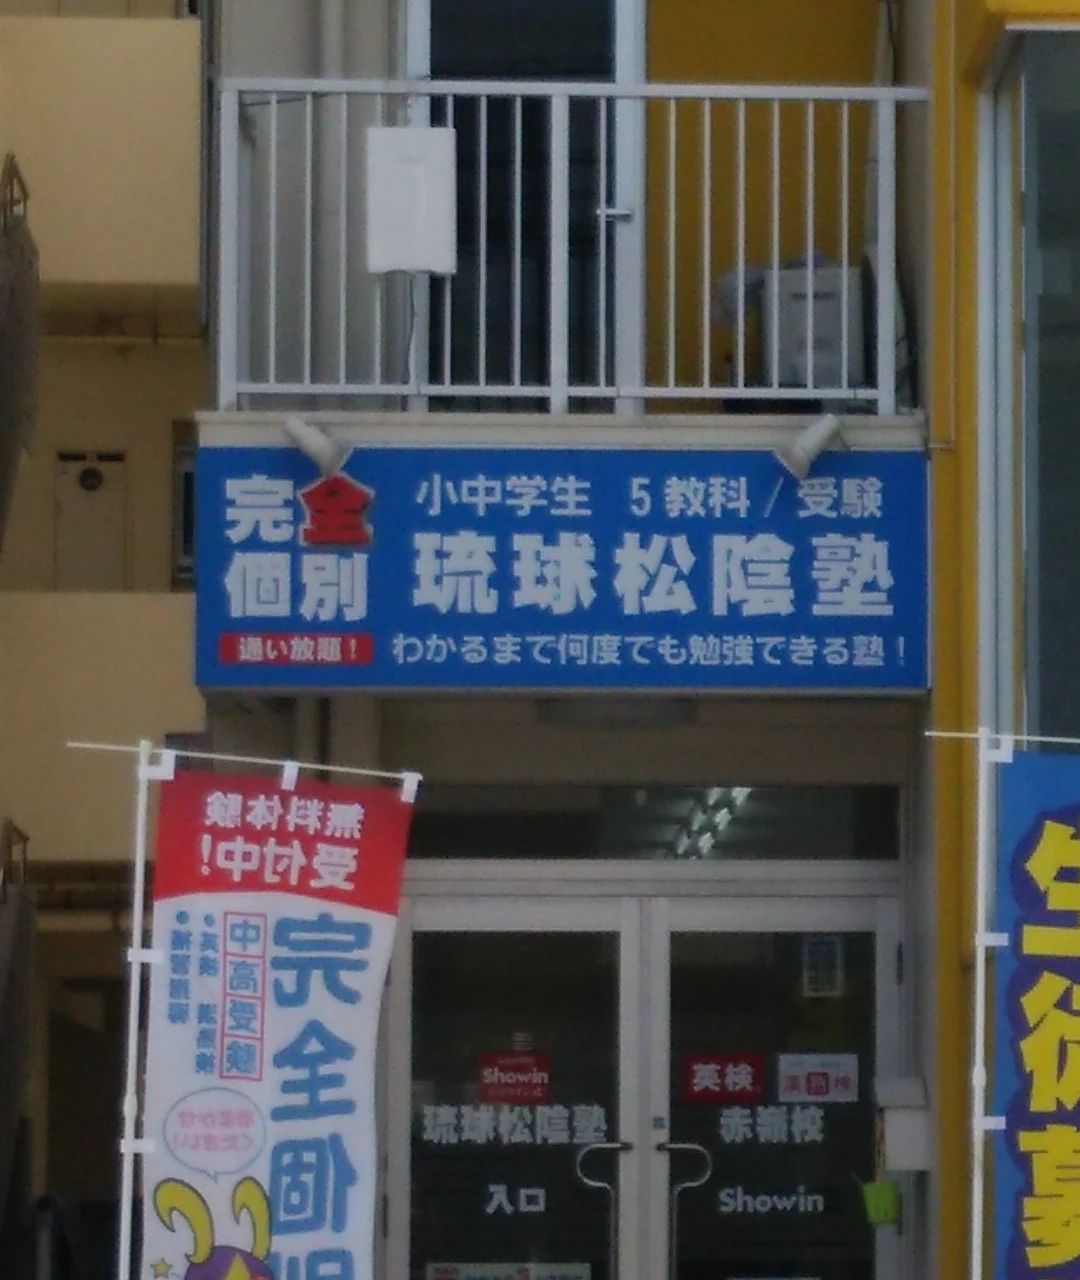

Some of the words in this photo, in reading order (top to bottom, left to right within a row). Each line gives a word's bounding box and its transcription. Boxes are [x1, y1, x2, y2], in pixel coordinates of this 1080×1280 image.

[225, 471, 375, 548] 完全
[416, 475, 592, 518] 小中学生
[223, 551, 370, 622] 個別
[411, 530, 896, 617] 琉球松陰塾
[238, 636, 360, 663] 通い放題!
[392, 632, 908, 668] わかるまで何度でも勉強できる塾!
[482, 1065, 550, 1085] Showin
[485, 1183, 546, 1215] 入口
[719, 1185, 825, 1214] Showin
